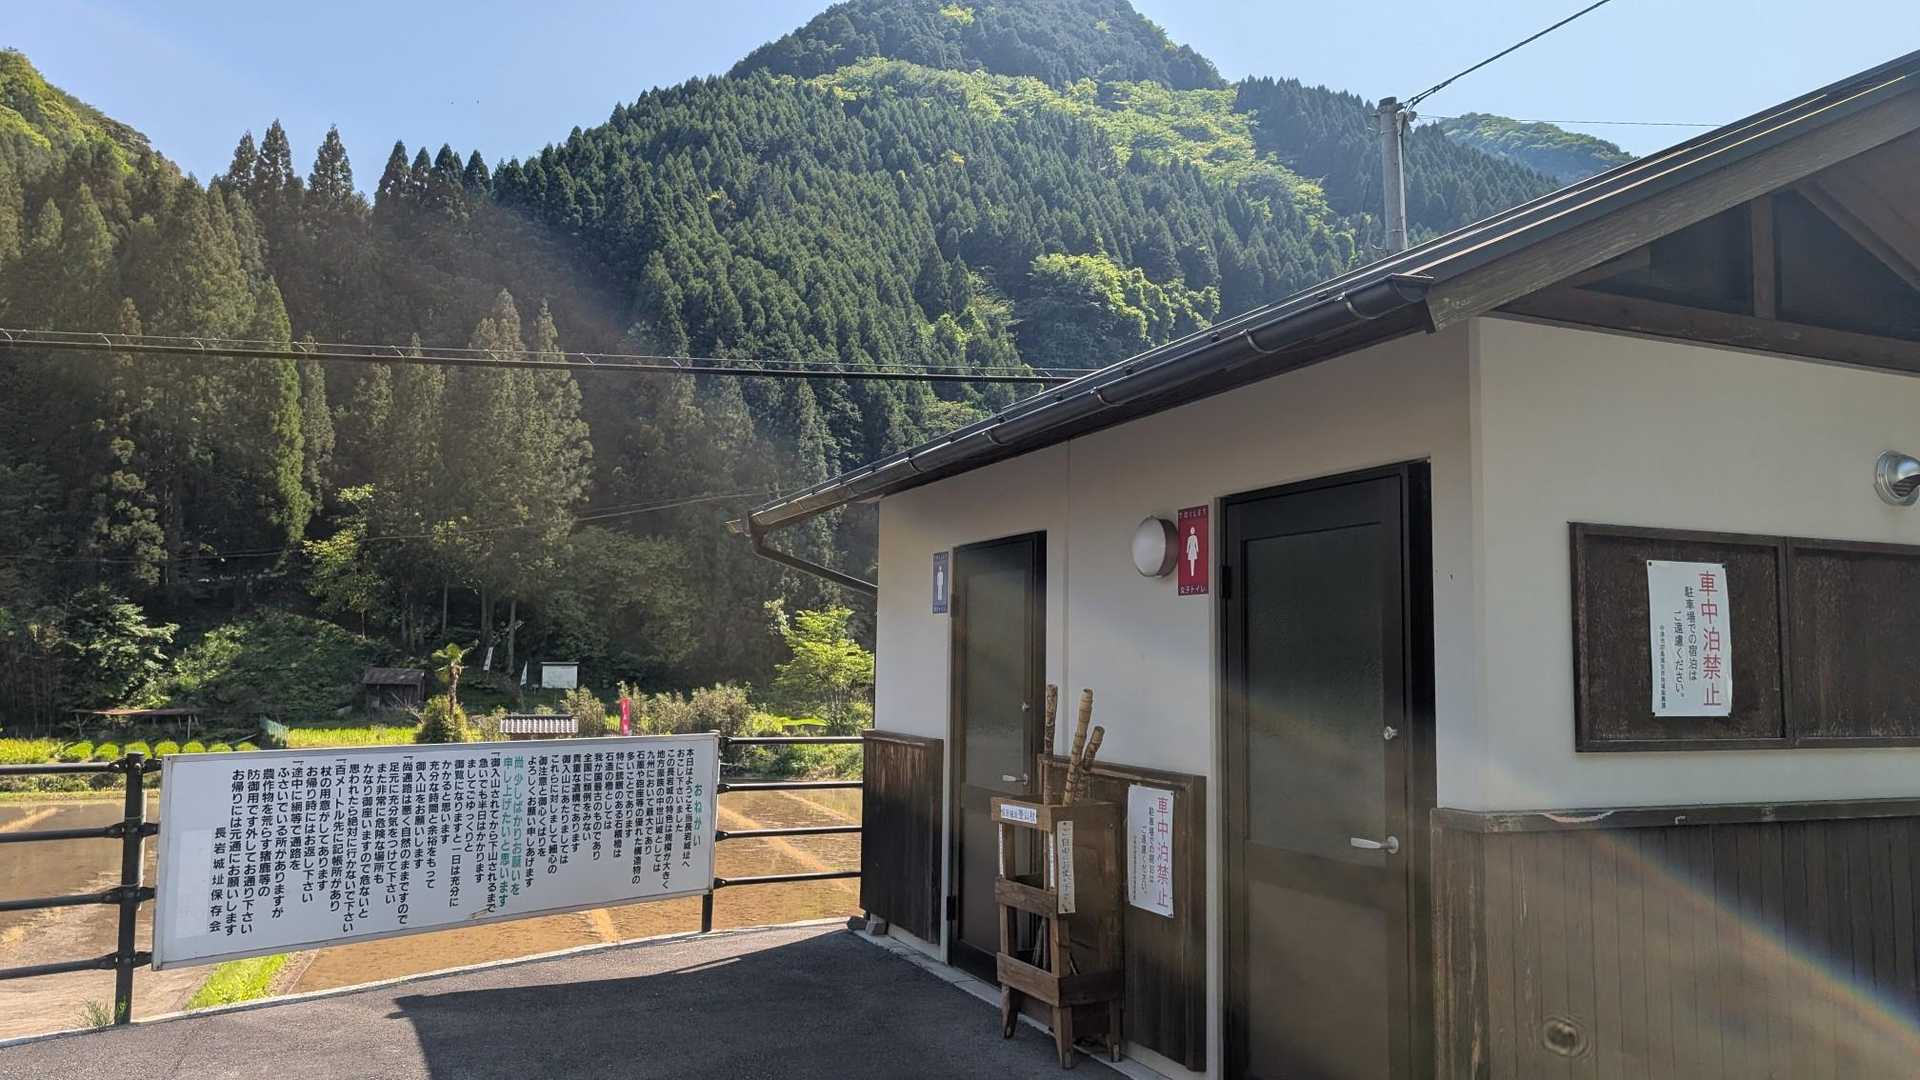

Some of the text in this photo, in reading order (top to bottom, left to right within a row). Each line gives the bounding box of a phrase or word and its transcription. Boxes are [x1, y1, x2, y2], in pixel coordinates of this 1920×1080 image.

[1180, 586, 1206, 594] 女子トイレ
[1685, 586, 1698, 681] 駐車場での宿泊は
[1698, 570, 1721, 707] 車中泊禁止
[1673, 611, 1685, 698] ご遠慮ください。
[258, 768, 274, 897] 農作物を荒らす猪鹿等の
[302, 766, 317, 903] お帰り時にはお返し下さい
[318, 766, 331, 891] 杖の用意がしてあります
[343, 764, 360, 932] 思われたら絶対に行かないで下さい
[358, 763, 374, 919] かなり御座いますので危ないと
[374, 763, 387, 884] また非常に危険な場所も
[385, 762, 400, 904] 足元に充分気をつけて下さい
[414, 761, 426, 869] 御入山をお願いします
[426, 761, 439, 889] 充分な時間と余裕をもって
[441, 760, 452, 845] かかると思います
[450, 759, 465, 908] 御覧になりますと一日は充分に
[475, 758, 489, 883] 急いでも半日はかかります
[499, 756, 513, 907] 申し上げたいと思います
[525, 756, 537, 888] よろしくお願い申しあげます
[537, 755, 548, 857] 御注意と御心くばりを
[548, 754, 560, 874] これらに対しまして細心の
[560, 754, 571, 865] 御入山にあたりましては
[571, 753, 582, 853] 貴重な遺構であります
[582, 752, 593, 841] 全国に類例をみない
[592, 752, 603, 860] 我が国最古のものであり
[625, 752, 635, 838] 多いことであります
[645, 751, 655, 855] 九州において最大であり
[653, 749, 665, 872] 地方豪族の中世山城としては
[662, 749, 675, 889] この長岩城の特色は規模が大きく
[675, 749, 685, 833] おこし下さいました
[693, 784, 702, 846] おねがい
[209, 827, 226, 933] 長岩城址保存会
[225, 769, 244, 936] お帰りには元通にお願いします
[241, 769, 260, 934] 防御用です外してお通り下さい
[1157, 797, 1168, 907] 車中泊禁止
